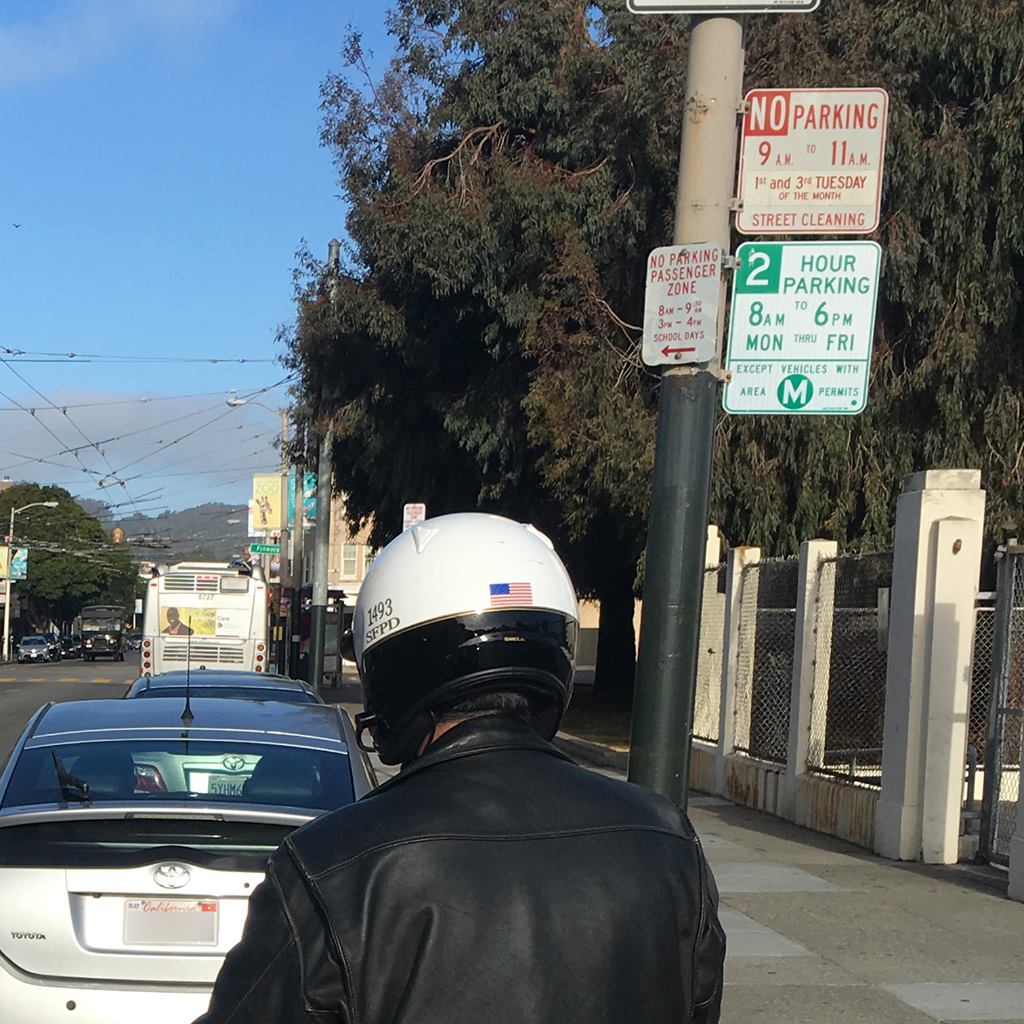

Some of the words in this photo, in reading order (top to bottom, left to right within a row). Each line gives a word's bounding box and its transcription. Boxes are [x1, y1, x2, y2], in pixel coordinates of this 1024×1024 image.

[749, 95, 787, 131] NO
[792, 103, 879, 130] PARKING
[758, 141, 772, 166] 9
[807, 144, 816, 154] TO
[831, 140, 847, 166] 11
[755, 176, 767, 189] 1st
[770, 177, 791, 189] and
[796, 176, 812, 190] 3rd
[816, 175, 867, 189] TUESDAY
[779, 192, 789, 200] OF
[794, 191, 809, 200] THE
[813, 191, 841, 200] MONTH
[752, 212, 798, 227] STREET
[801, 212, 865, 226] CLEANING
[650, 254, 665, 268] NO
[669, 248, 718, 266] PARKING
[650, 263, 716, 283] PASSENGER
[745, 252, 771, 286] 2
[801, 255, 856, 272] HOUR
[667, 281, 696, 296] ZONE
[783, 277, 870, 294] PARKING
[795, 301, 807, 310] TO
[653, 332, 682, 342] SCHOOL
[685, 331, 705, 341] DAYS
[746, 334, 783, 351] MON
[794, 334, 817, 343] THRU
[827, 334, 854, 351] FRI
[736, 365, 773, 373] EXCEPT
[781, 365, 827, 373] VEHICLES
[836, 365, 859, 373] WITH
[740, 387, 766, 396] AREA
[782, 380, 808, 404] M
[819, 387, 859, 396] PERMITS
[367, 598, 393, 627] 1493
[366, 616, 401, 644] SFPD
[212, 783, 242, 796] 5YHM6
[11, 932, 47, 940] TOYOTA
